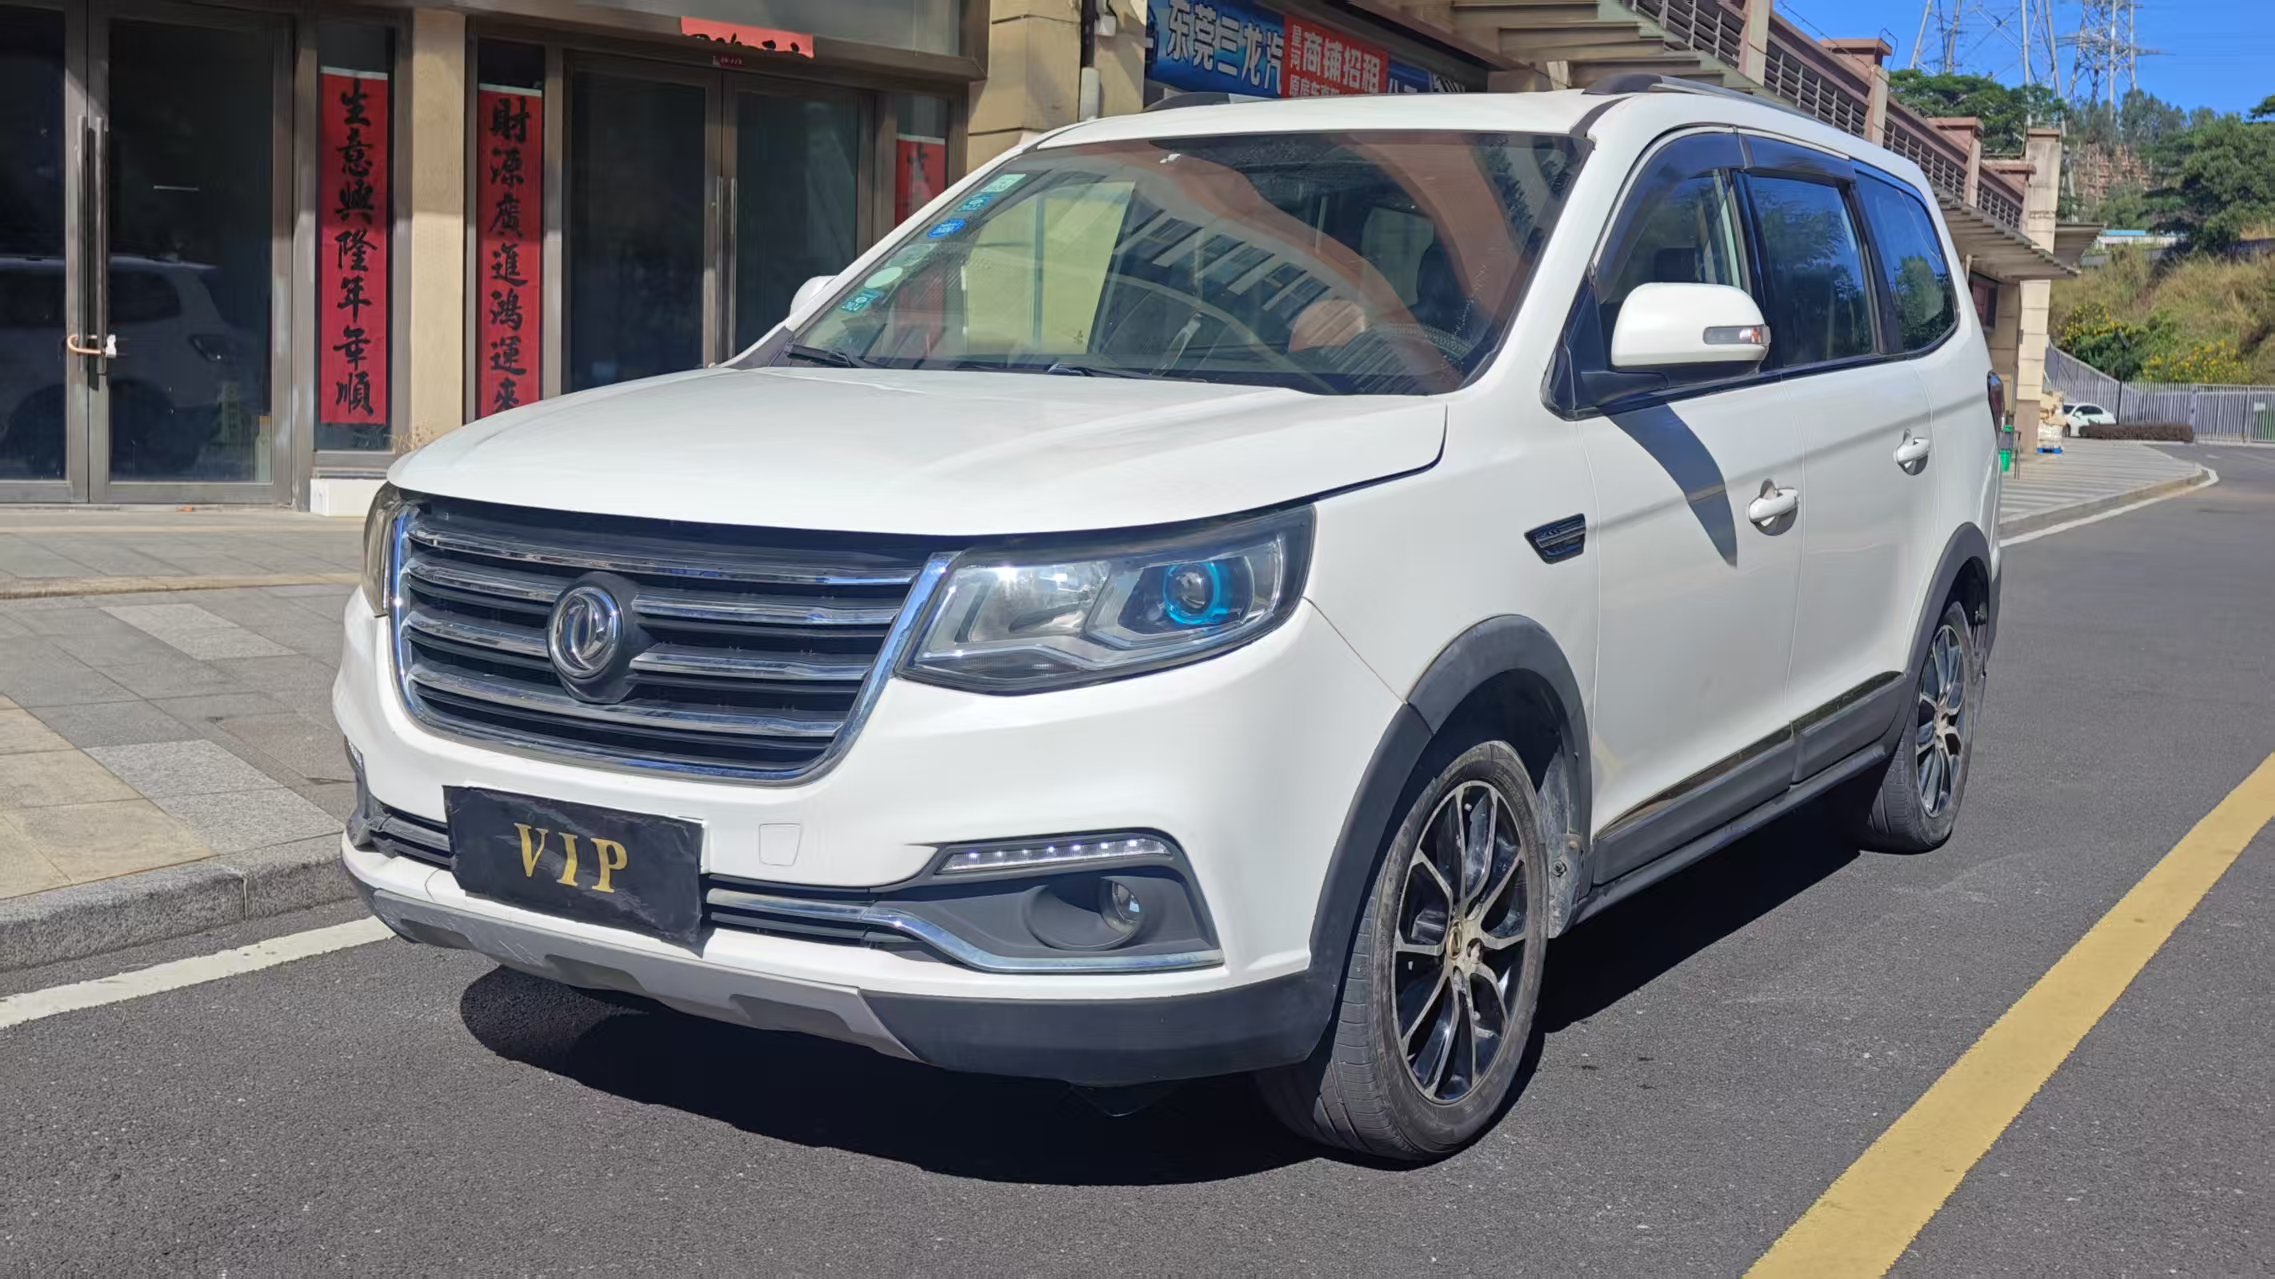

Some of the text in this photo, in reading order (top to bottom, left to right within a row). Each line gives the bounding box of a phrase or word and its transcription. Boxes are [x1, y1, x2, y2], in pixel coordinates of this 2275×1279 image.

[1303, 32, 1380, 94] 商铺招租
[514, 823, 628, 893] VIP
